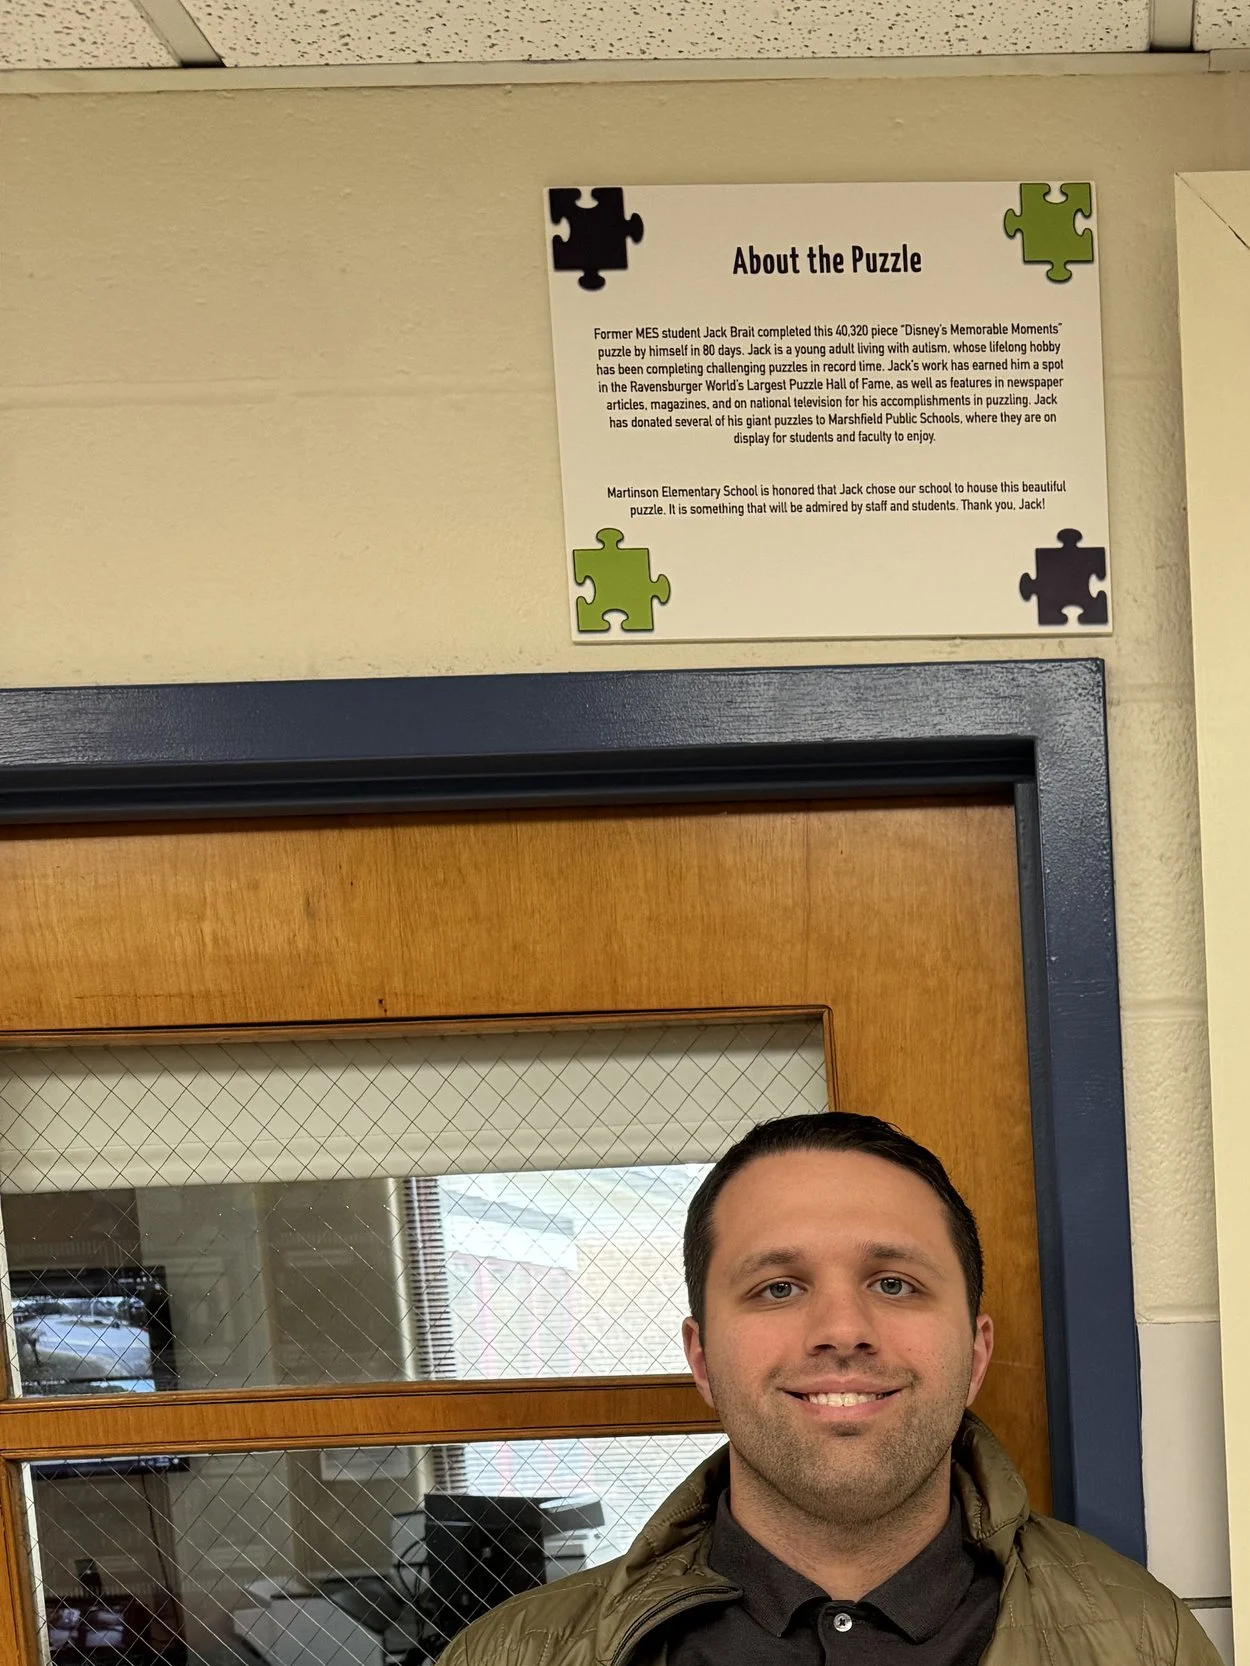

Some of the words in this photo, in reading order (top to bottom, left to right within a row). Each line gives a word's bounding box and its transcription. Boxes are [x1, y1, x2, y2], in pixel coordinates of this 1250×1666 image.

[733, 245, 800, 275] About
[806, 244, 844, 274] the
[852, 244, 921, 273] Puzzle
[594, 328, 633, 340] Former
[636, 327, 659, 339] MES
[661, 327, 701, 338] student
[703, 326, 727, 338] Jack
[730, 326, 755, 338] Brait
[757, 325, 811, 339] completed
[814, 325, 833, 336] this
[871, 324, 898, 338] piece
[950, 323, 1008, 335] Memorable
[598, 345, 631, 359] puzzle
[634, 345, 646, 359] by
[649, 344, 688, 357] himself
[690, 344, 701, 356] in
[703, 344, 715, 356] 80
[718, 344, 744, 358] days.
[747, 343, 772, 355] Jack
[774, 343, 783, 355] is
[786, 346, 792, 355] a
[794, 346, 826, 357] young
[829, 342, 855, 354] adult
[857, 342, 884, 356] living
[887, 341, 909, 354] with
[953, 341, 987, 353] whose
[989, 341, 1027, 355] lifelong
[1030, 340, 1060, 354] hobby
[596, 364, 615, 375] has
[618, 363, 644, 375] been
[646, 362, 704, 375] completing
[706, 361, 766, 374] challenging
[769, 361, 808, 374] puzzles
[810, 360, 820, 372] in
[823, 360, 856, 372] record
[859, 360, 885, 372] time.
[887, 359, 919, 371] Jack's
[922, 359, 948, 371] work
[951, 359, 969, 371] has
[972, 358, 1008, 370] earned
[1011, 358, 1030, 370] him
[1033, 361, 1039, 370] a
[1042, 359, 1064, 372] spot
[598, 381, 608, 393] in
[611, 381, 627, 392] the
[630, 380, 703, 393] Ravensburger
[705, 379, 744, 391] World's
[747, 379, 787, 392] Largest
[788, 378, 823, 390] Puzzle
[826, 377, 847, 390] Hall
[849, 378, 860, 390] of
[896, 380, 908, 389] as
[911, 377, 933, 389] well
[935, 380, 947, 388] as
[950, 377, 992, 388] features
[995, 376, 1004, 388] in
[1007, 378, 1064, 390] newspaper
[712, 397, 731, 409] and
[734, 400, 747, 408] on
[750, 396, 791, 408] national
[793, 396, 842, 408] television
[845, 395, 860, 407] for
[862, 395, 878, 407] his
[880, 394, 971, 408] accomplishments
[974, 394, 983, 405] in
[986, 393, 1031, 408] puzzling.
[1034, 393, 1057, 405] Jack
[609, 417, 628, 428] has
[631, 415, 672, 427] donated
[675, 415, 712, 427] several
[715, 415, 726, 426] of
[727, 415, 743, 426] his
[746, 414, 772, 428] giant
[774, 414, 813, 427] puzzles
[816, 414, 825, 425] to
[828, 413, 883, 425] Marshfield
[885, 412, 917, 424] Public
[965, 411, 997, 423] where
[1000, 411, 1022, 425] they
[1024, 414, 1041, 422] are
[1044, 414, 1056, 422] on
[734, 432, 770, 446] display
[772, 432, 787, 443] for
[789, 431, 834, 443] students
[836, 431, 855, 442] and
[858, 430, 892, 444] faculty
[894, 431, 904, 441] to
[907, 429, 935, 444] enjoy.
[608, 487, 659, 498] Martinson
[662, 486, 721, 498] Elementary
[723, 485, 758, 496] School
[761, 484, 769, 496] is
[772, 484, 815, 496] honored
[818, 484, 837, 495] that
[839, 483, 863, 495] Jack
[866, 483, 896, 494] chose
[898, 485, 916, 494] our
[918, 482, 953, 494] school
[955, 483, 964, 493] to
[967, 482, 998, 493] house
[1000, 481, 1019, 493] this
[1022, 480, 1066, 492] beautiful
[630, 503, 666, 517] puzzle.
[669, 503, 676, 515] It
[678, 503, 687, 515] is
[690, 502, 744, 516] something
[747, 502, 767, 514] that
[769, 501, 788, 513] will
[790, 502, 803, 513] be
[806, 500, 848, 512] admired
[851, 500, 863, 514] by
[866, 500, 888, 512] staff
[890, 500, 909, 511] and
[912, 499, 958, 511] students.
[961, 499, 993, 510] Thank
[1019, 498, 1045, 509] Jack!
